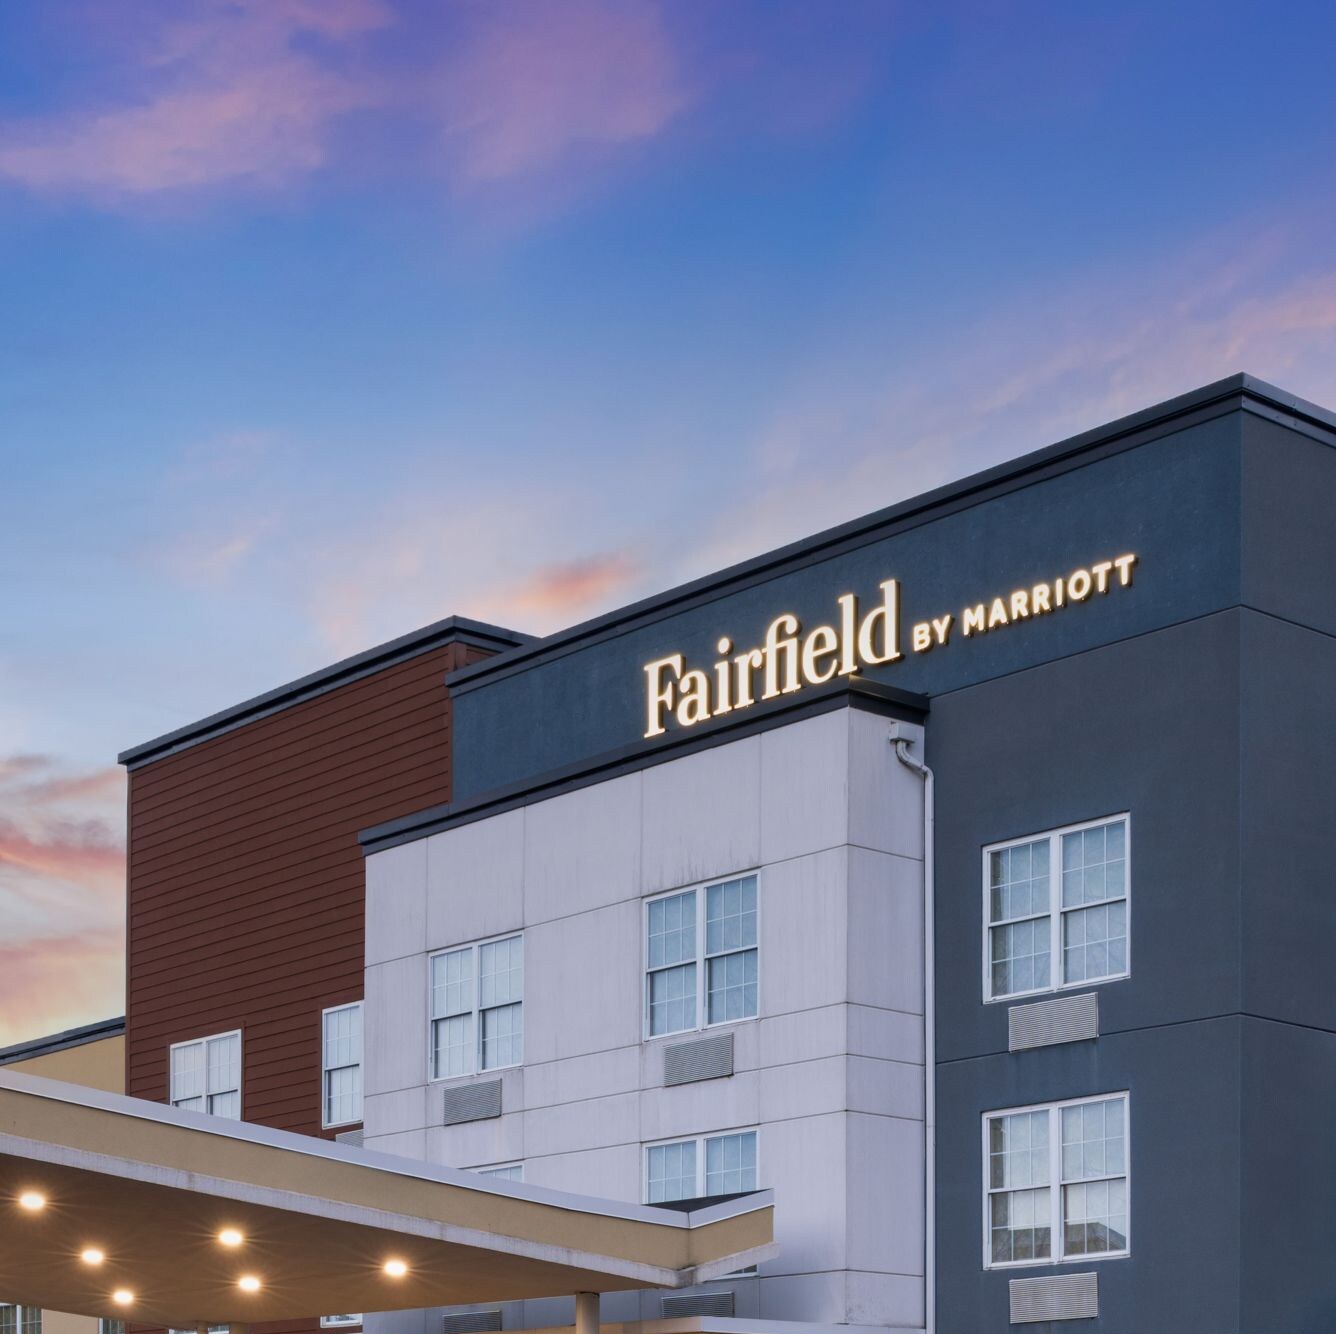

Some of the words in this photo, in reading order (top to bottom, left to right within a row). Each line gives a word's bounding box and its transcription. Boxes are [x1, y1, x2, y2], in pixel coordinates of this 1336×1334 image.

[643, 579, 902, 738] Fairfield
[912, 615, 951, 652] BY
[963, 554, 1137, 636] MARRIOTT
